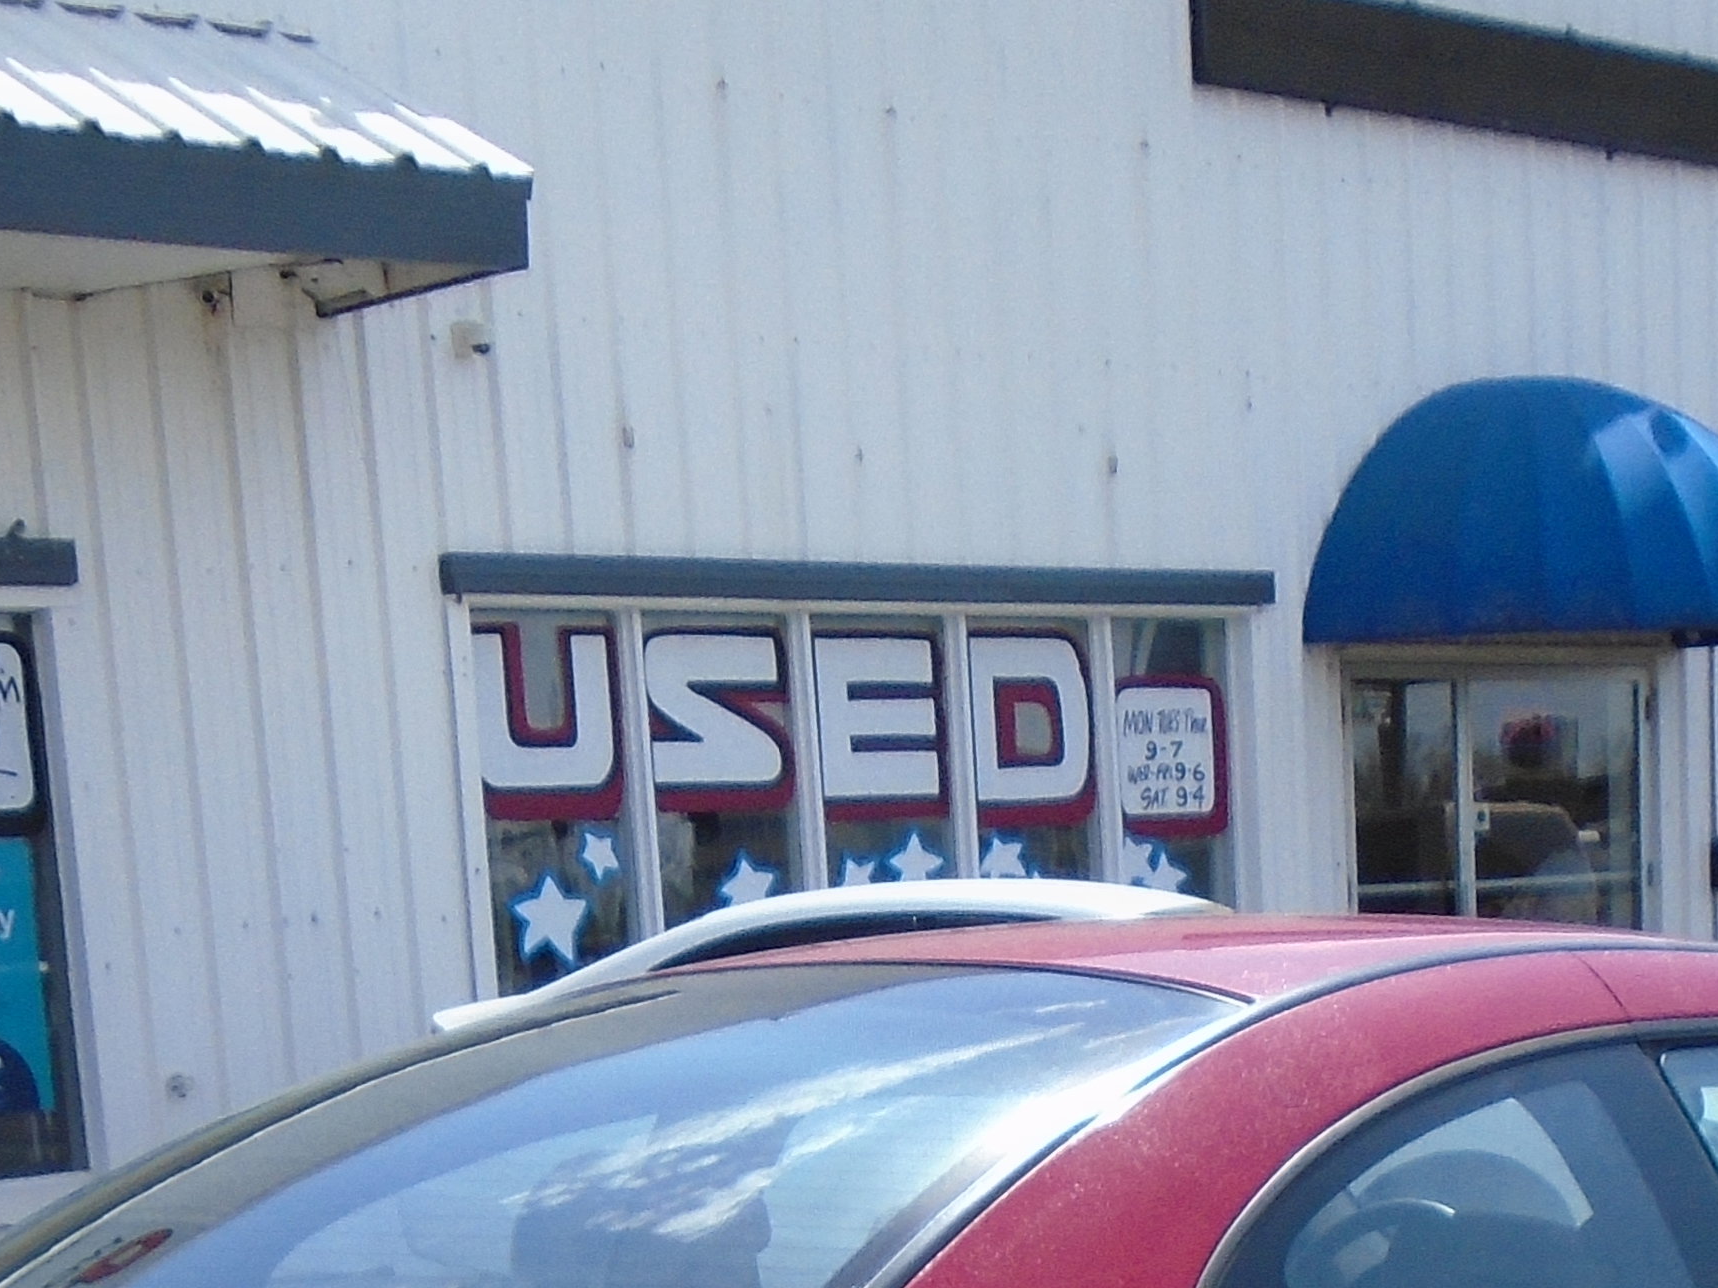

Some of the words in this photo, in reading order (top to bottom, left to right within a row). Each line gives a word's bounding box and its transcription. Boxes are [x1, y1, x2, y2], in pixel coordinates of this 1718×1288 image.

[471, 625, 1089, 802] USED
[1145, 740, 1184, 761] 9-7
[1140, 786, 1169, 811] SAT
